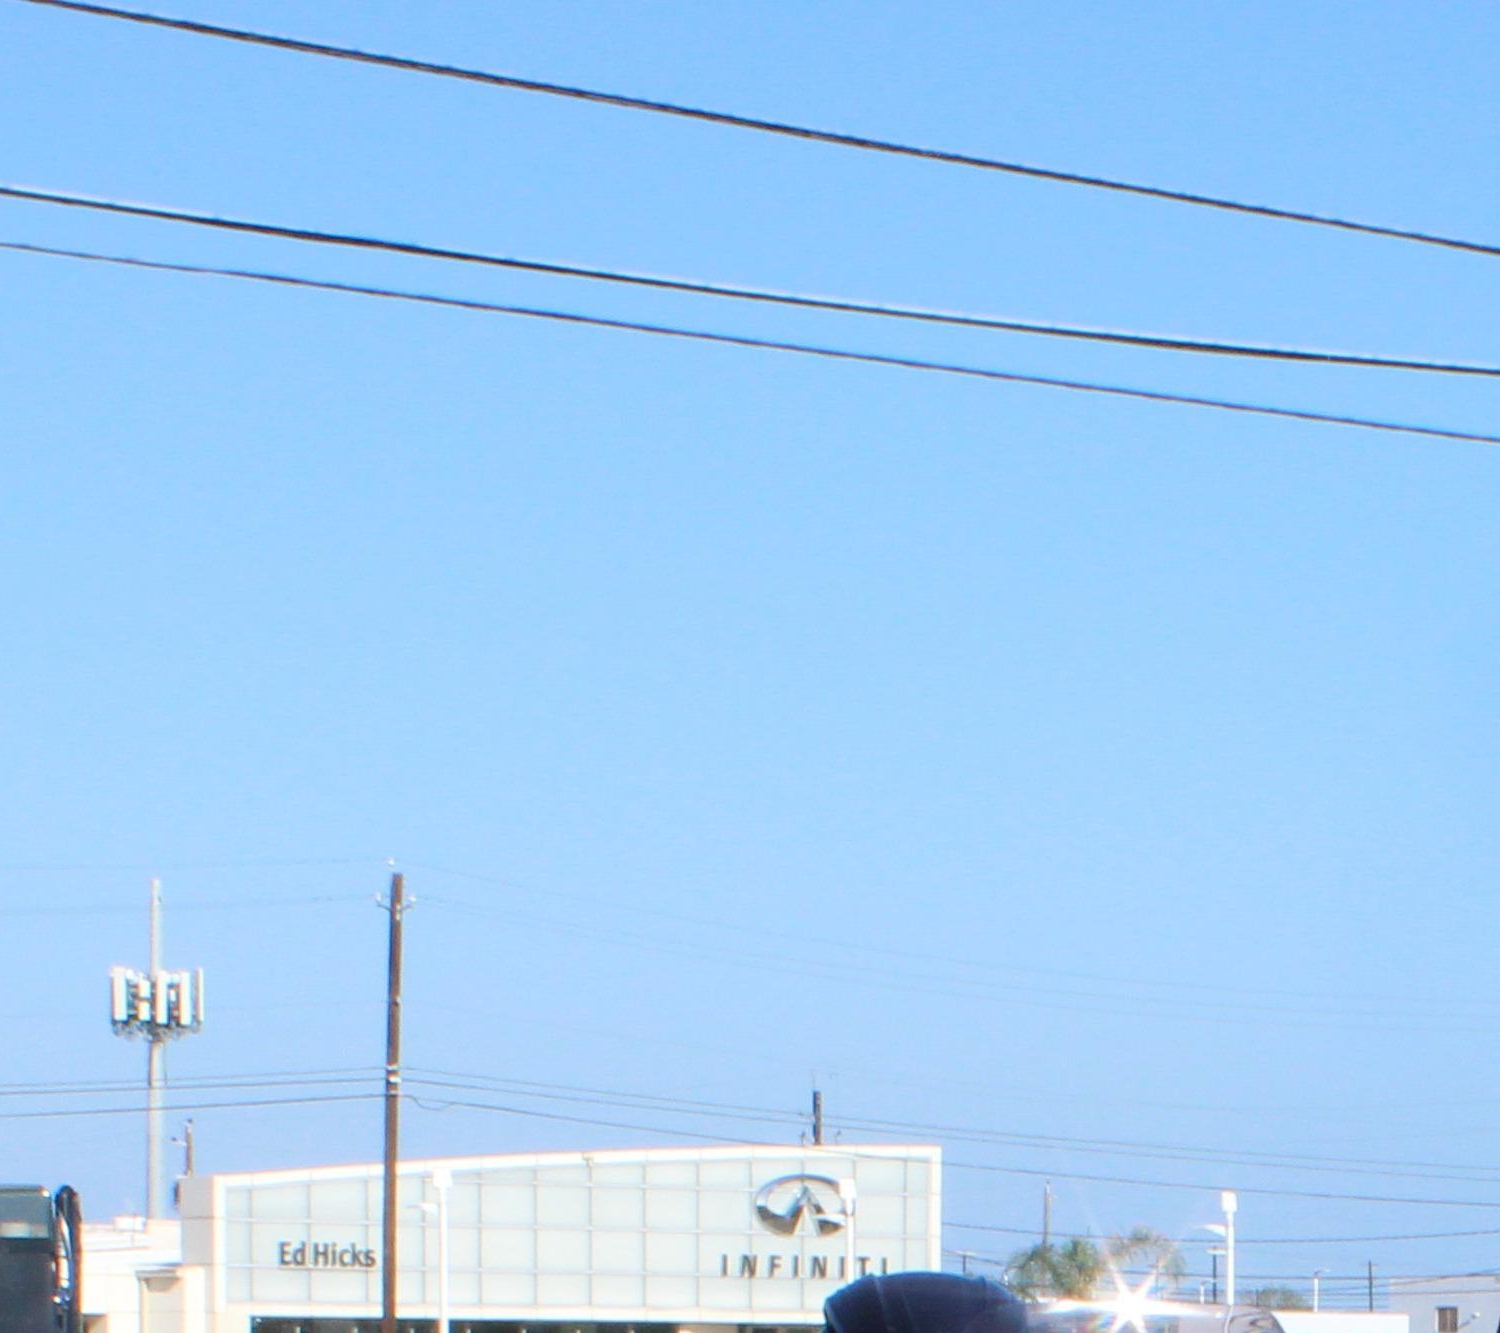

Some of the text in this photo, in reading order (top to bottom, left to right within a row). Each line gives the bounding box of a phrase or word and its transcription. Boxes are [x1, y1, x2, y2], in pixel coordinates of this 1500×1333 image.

[279, 1240, 377, 1269] Ed Hicks
[721, 1253, 889, 1279] INFINITI
